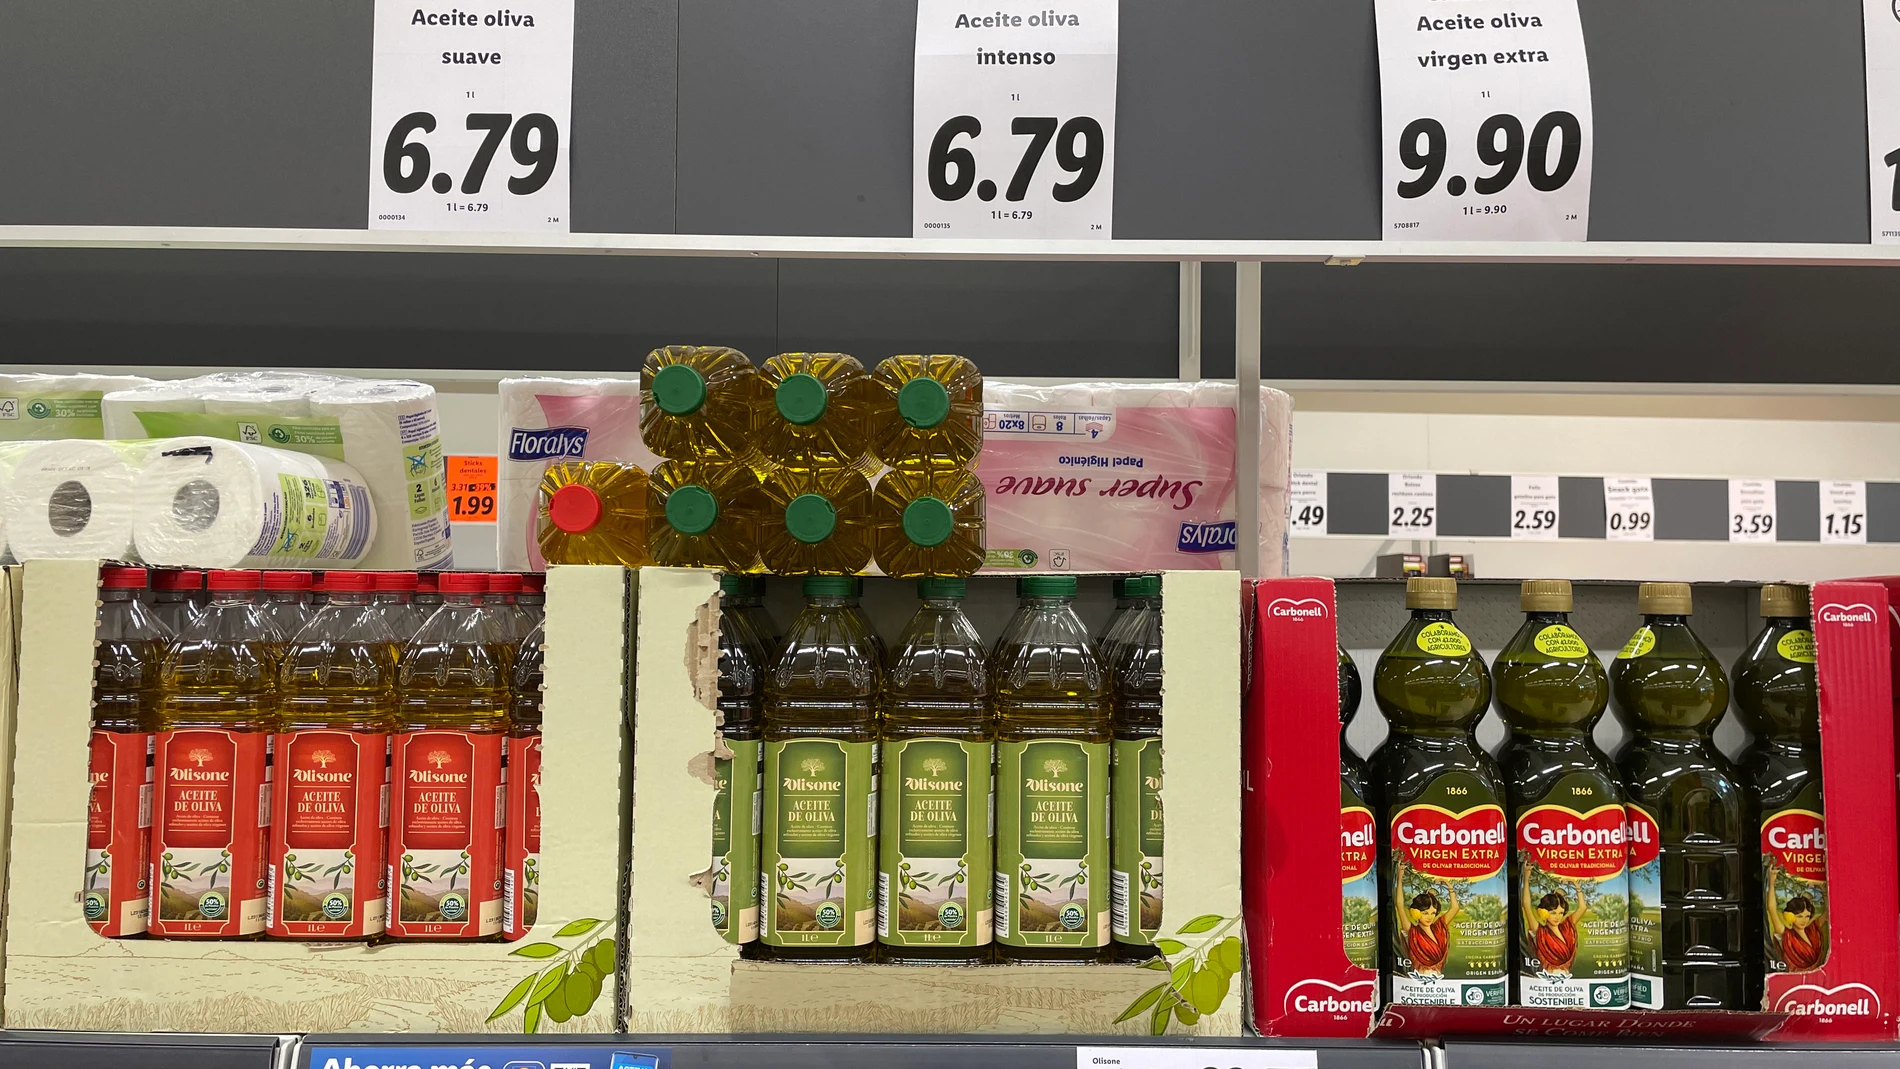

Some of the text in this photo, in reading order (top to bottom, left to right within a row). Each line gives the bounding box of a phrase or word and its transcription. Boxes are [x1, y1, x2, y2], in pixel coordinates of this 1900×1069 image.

[411, 8, 535, 27] Aceite oliva
[955, 9, 1080, 29] Aceite oliva
[1417, 12, 1543, 32] Aceite oliva
[441, 51, 501, 65] suave
[977, 47, 1056, 65] intenso
[1417, 49, 1549, 71] virgen extra
[383, 111, 559, 195] 6.79
[1397, 110, 1582, 199] 9.90
[927, 115, 1105, 203] 6.79
[467, 203, 489, 212] 6.79
[1484, 205, 1507, 215] 9.90
[1011, 211, 1033, 220] 6.79
[55, 409, 75, 417] 30%
[998, 419, 1025, 431] 8x20
[1056, 420, 1064, 431] 8
[294, 435, 315, 443] 30%
[1091, 428, 1099, 439] 4
[511, 432, 585, 460] Floralys
[1058, 455, 1144, 468] Papel Higiénico
[451, 483, 468, 492] 3.31
[995, 473, 1203, 511] Super suave
[453, 495, 494, 515] 1.99
[1391, 506, 1435, 527] 2.25
[1514, 509, 1556, 530] 2.59
[1610, 512, 1651, 530] 0.99
[1732, 514, 1773, 534] 3.59
[1825, 513, 1864, 535] 1.15
[1273, 606, 1322, 617] Carbonell
[1823, 611, 1872, 623] Carbonell
[1427, 644, 1467, 652] AGRICULTORES
[1789, 643, 1804, 651] CON
[170, 767, 230, 782] Olisone
[293, 769, 353, 783] Olisone
[409, 769, 468, 783] Olisone
[783, 777, 841, 792] Olisone
[905, 777, 963, 792] Olisone
[1025, 778, 1084, 793] Olisone
[178, 790, 218, 801] ACEITE
[302, 791, 341, 802] ACEITE
[418, 791, 457, 802] ACEITE
[1446, 787, 1468, 796] 1866
[1571, 787, 1593, 796] 1866
[174, 801, 223, 812] DE OLIVA
[297, 803, 346, 814] DE OLIVA
[413, 803, 461, 814] DE OLIVA
[793, 800, 831, 811] ACEITE
[914, 800, 953, 811] ACEITE
[1035, 801, 1074, 811] ACEITE
[788, 811, 836, 822] DE OLIVA
[910, 811, 957, 822] DE OLIVA
[1031, 812, 1078, 823] DE OLIVA
[1397, 821, 1506, 846] Carbonell
[1410, 848, 1500, 860] VIRGEN EXTRA
[1536, 848, 1623, 860] VIRGEN EXTRA
[204, 898, 219, 906] 50%
[821, 908, 836, 916] 50%
[1483, 921, 1493, 929] DE
[1610, 920, 1619, 928] DE
[1587, 928, 1614, 936] VIRGEN
[1400, 985, 1456, 993] ACEITE DE OLIVA
[1528, 985, 1584, 993] ACEITE DE OLIVA
[1400, 996, 1456, 1005] SOSTENIBLE
[1528, 996, 1584, 1006] SOSTENIBLE
[1784, 999, 1870, 1016] Carbonell
[1502, 1014, 1697, 1029] UN LUGAR DONDE
[1514, 1028, 1533, 1036] SE
[1535, 1027, 1610, 1037] COME
[1092, 1057, 1121, 1066] Olisone
